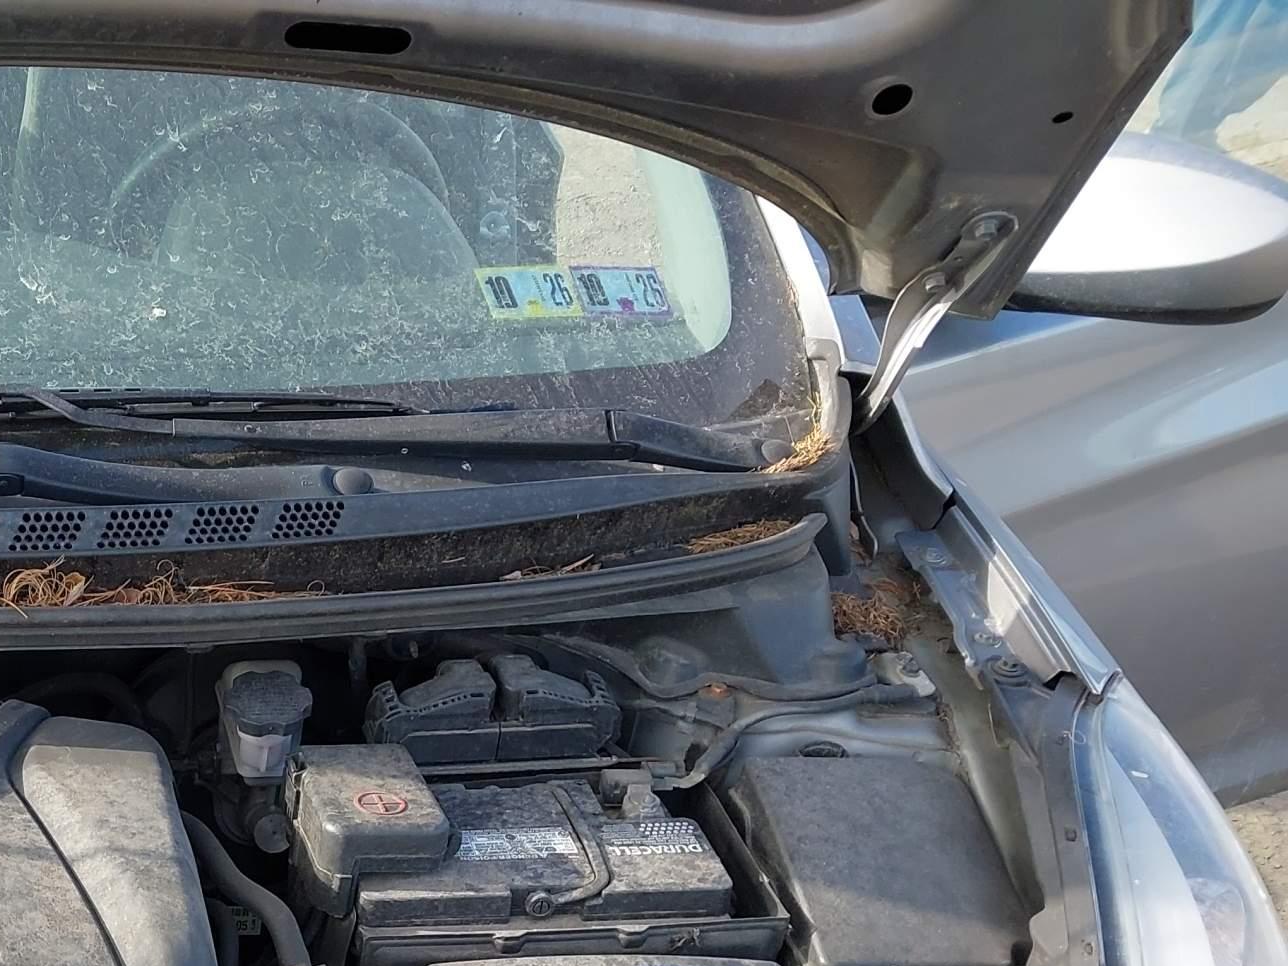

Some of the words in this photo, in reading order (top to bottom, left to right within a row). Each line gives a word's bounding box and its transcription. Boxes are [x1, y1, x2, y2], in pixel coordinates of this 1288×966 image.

[485, 276, 519, 308] 10
[543, 273, 574, 306] 26
[577, 273, 610, 307] 10
[607, 842, 704, 855] DURACELL
